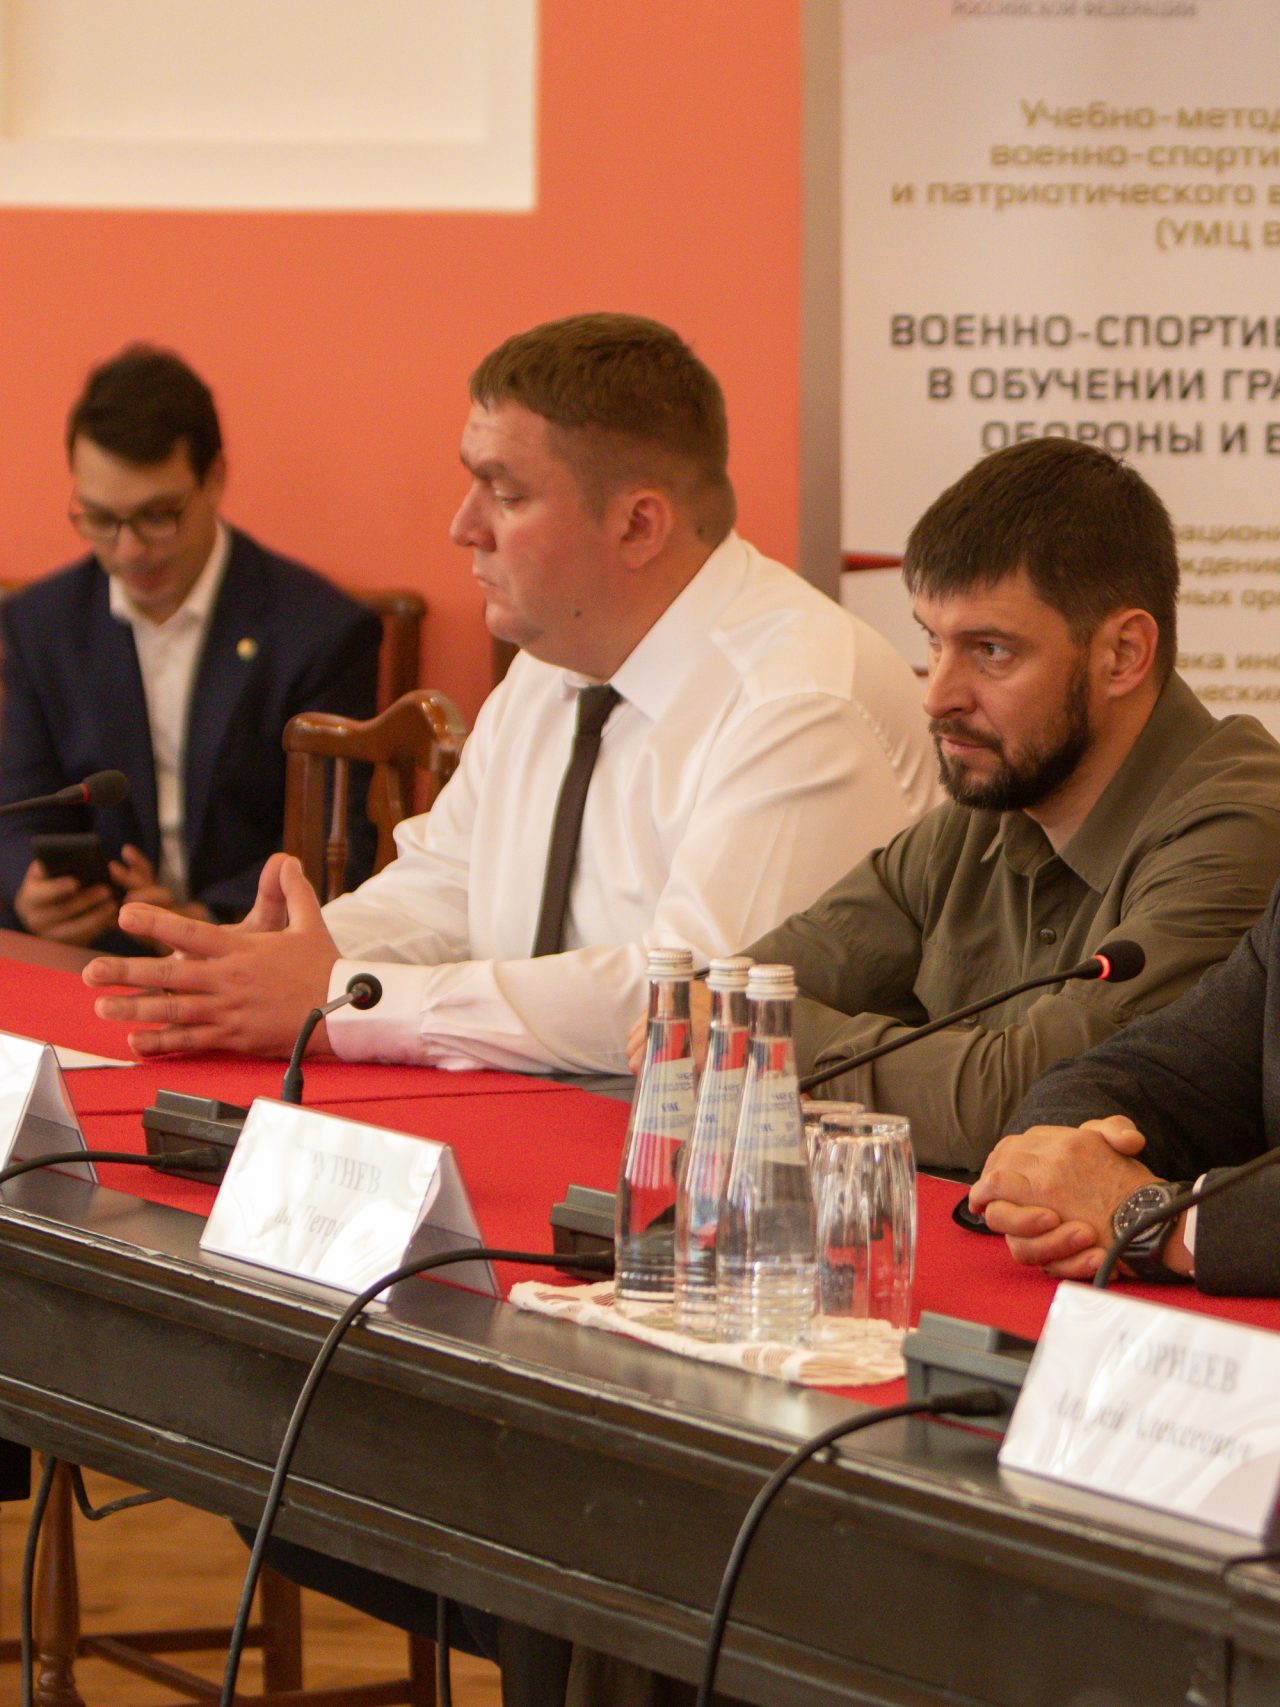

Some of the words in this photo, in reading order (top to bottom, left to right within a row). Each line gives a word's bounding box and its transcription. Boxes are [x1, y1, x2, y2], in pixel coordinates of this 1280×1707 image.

[891, 183, 915, 205] и
[926, 182, 1256, 211] патриотического
[1155, 216, 1253, 252] (УМЦ
[927, 367, 955, 402] В
[969, 367, 1206, 403] ОБУЧЕНИИ
[1220, 422, 1248, 456] И
